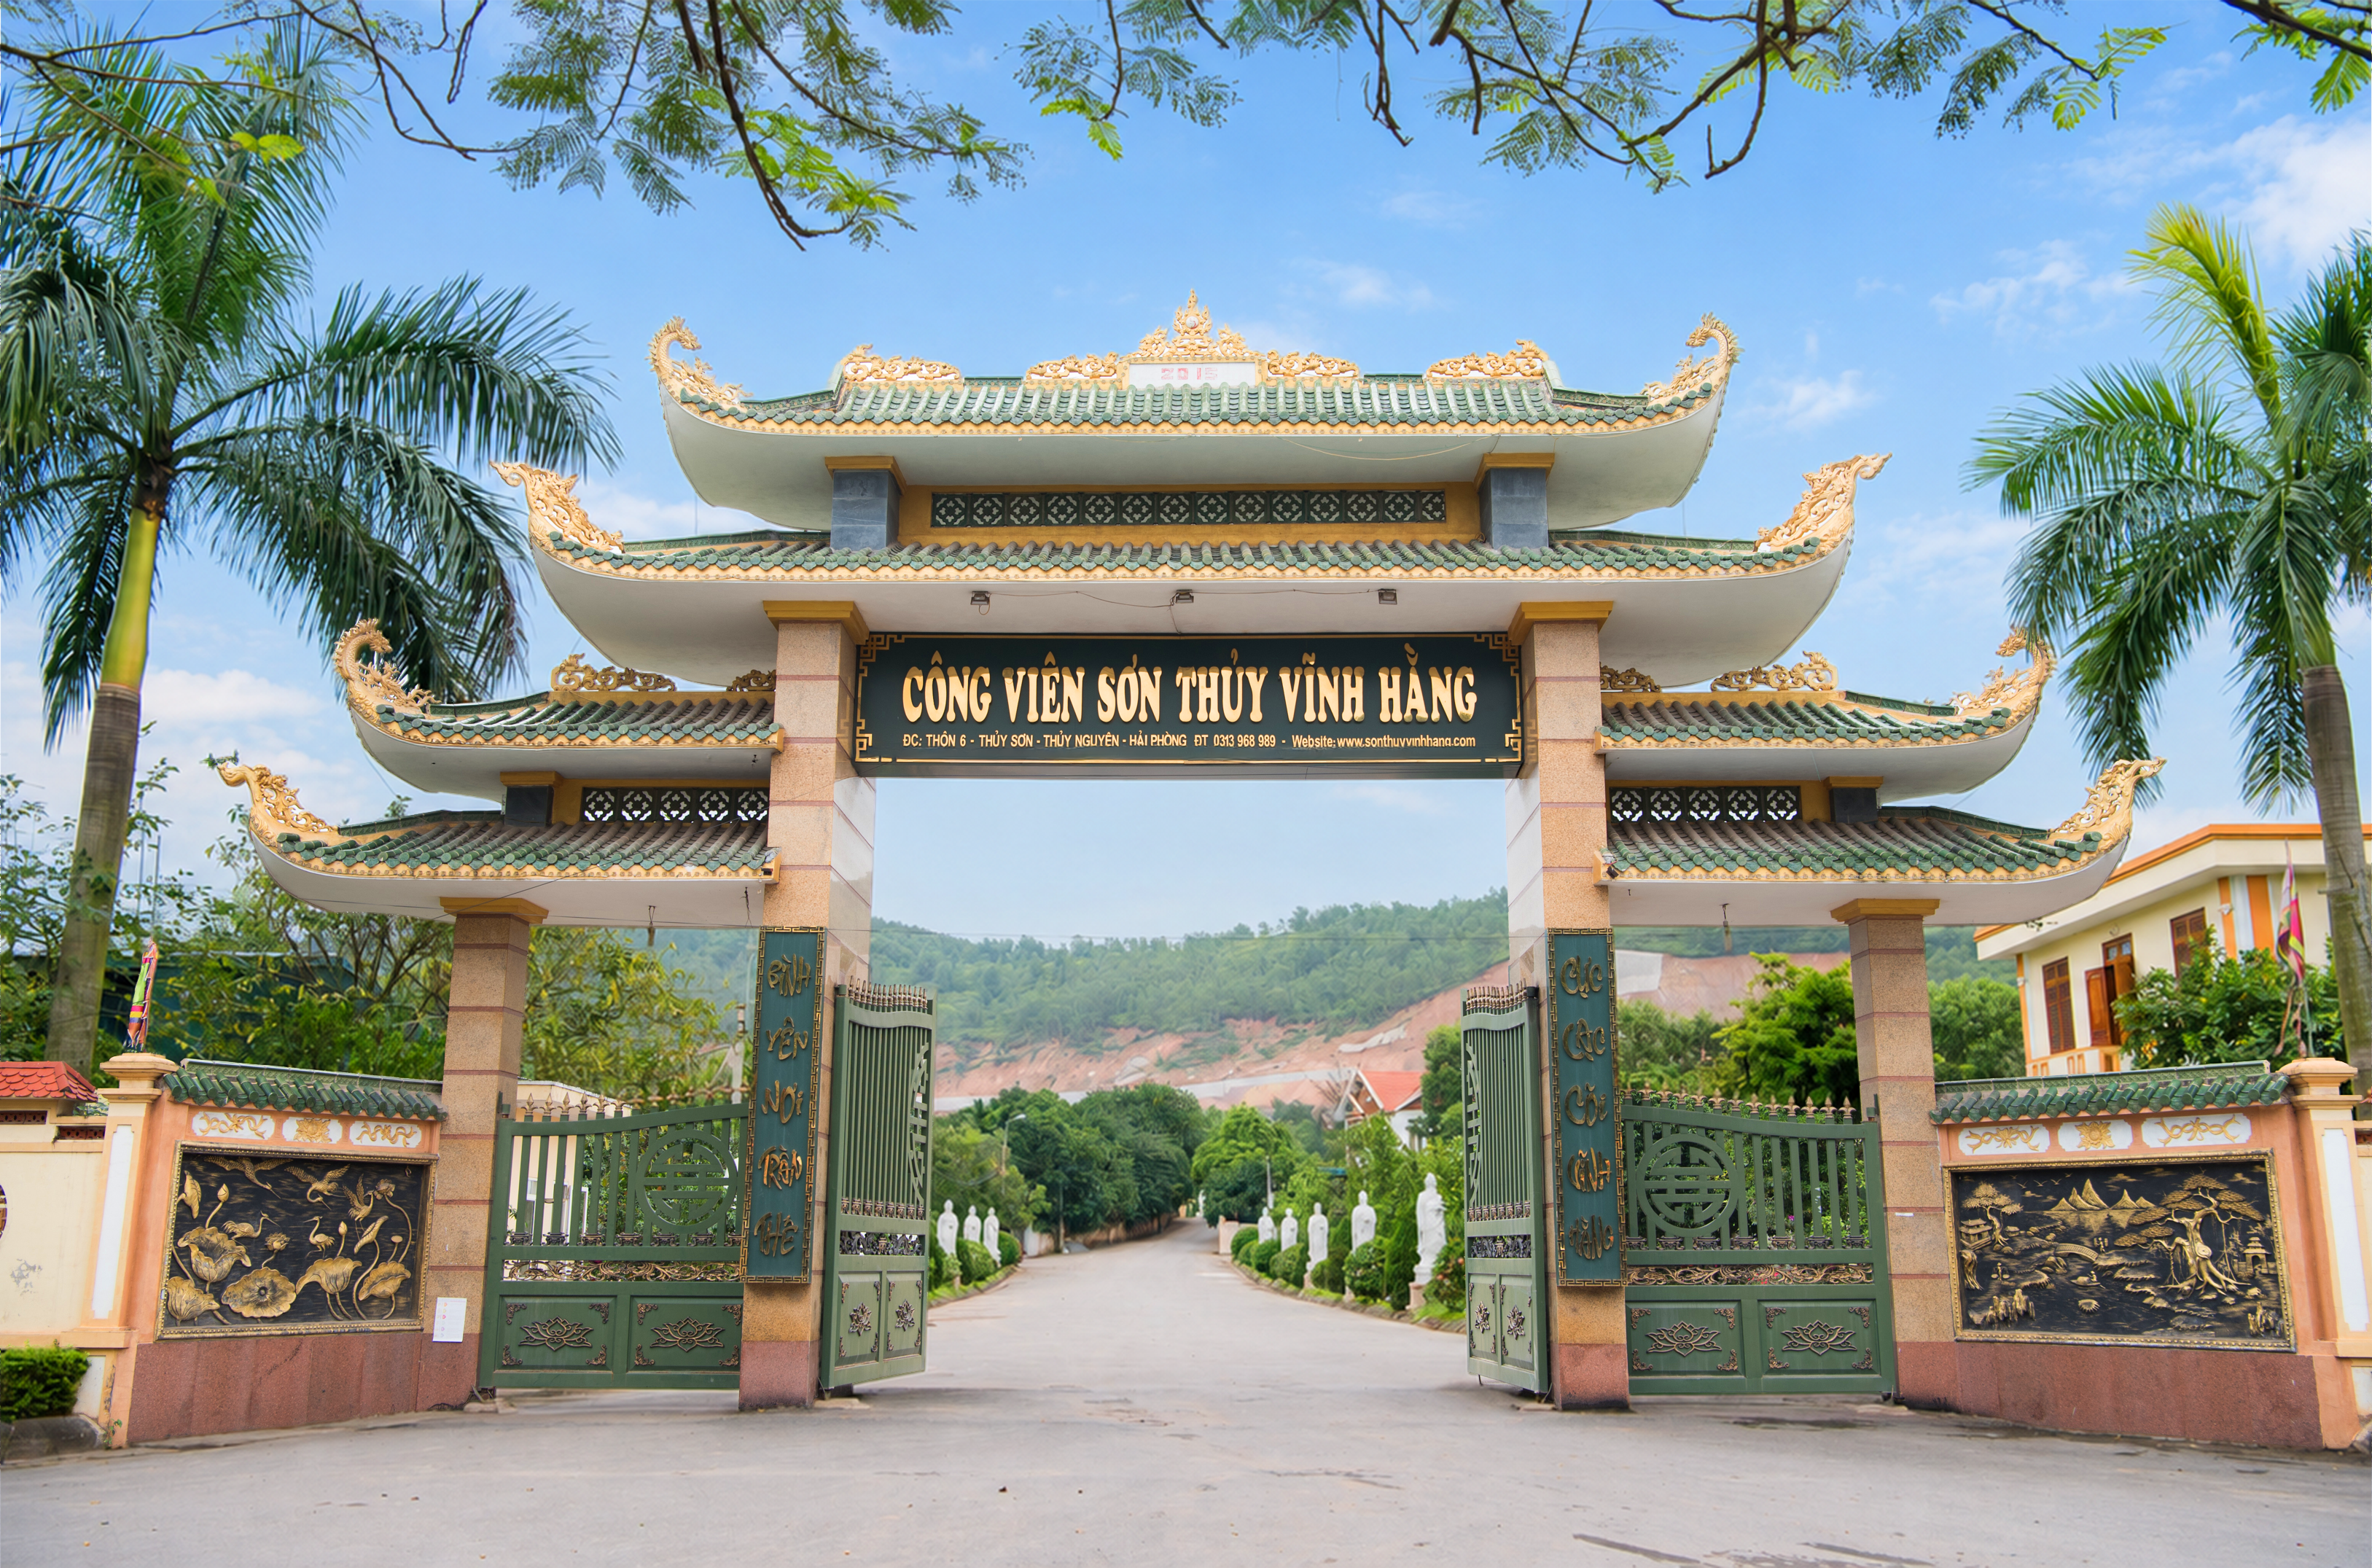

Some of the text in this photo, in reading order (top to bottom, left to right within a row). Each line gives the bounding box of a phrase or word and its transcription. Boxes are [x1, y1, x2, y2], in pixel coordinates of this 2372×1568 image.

[902, 650, 992, 722] CÔNG
[1002, 651, 1085, 723] VIÊN
[1175, 648, 1268, 722] THỦY
[1279, 652, 1365, 722] VĨNH
[1378, 643, 1477, 722] HẰNG
[902, 733, 922, 747] ĐC:
[926, 730, 956, 747] THÔN
[960, 733, 967, 747] 6
[979, 730, 1007, 747] THỦY
[1010, 733, 1034, 747] SƠN
[1043, 730, 1072, 747] THỦY
[1074, 731, 1120, 747] NGUYÊN
[1129, 730, 1148, 746] HẢI
[1151, 730, 1187, 747] PHÒNG
[1194, 734, 1209, 747] ĐT
[1213, 734, 1235, 747] 0313
[1237, 734, 1255, 747] 968
[1258, 734, 1276, 747] 989
[768, 953, 811, 996] BÌNH
[1561, 955, 1603, 999] CỰC
[765, 1016, 808, 1060] YÊN
[758, 1145, 802, 1190] TRẦN
[1567, 1147, 1612, 1192] VĨNH
[1569, 1214, 1614, 1260] HẰNG
